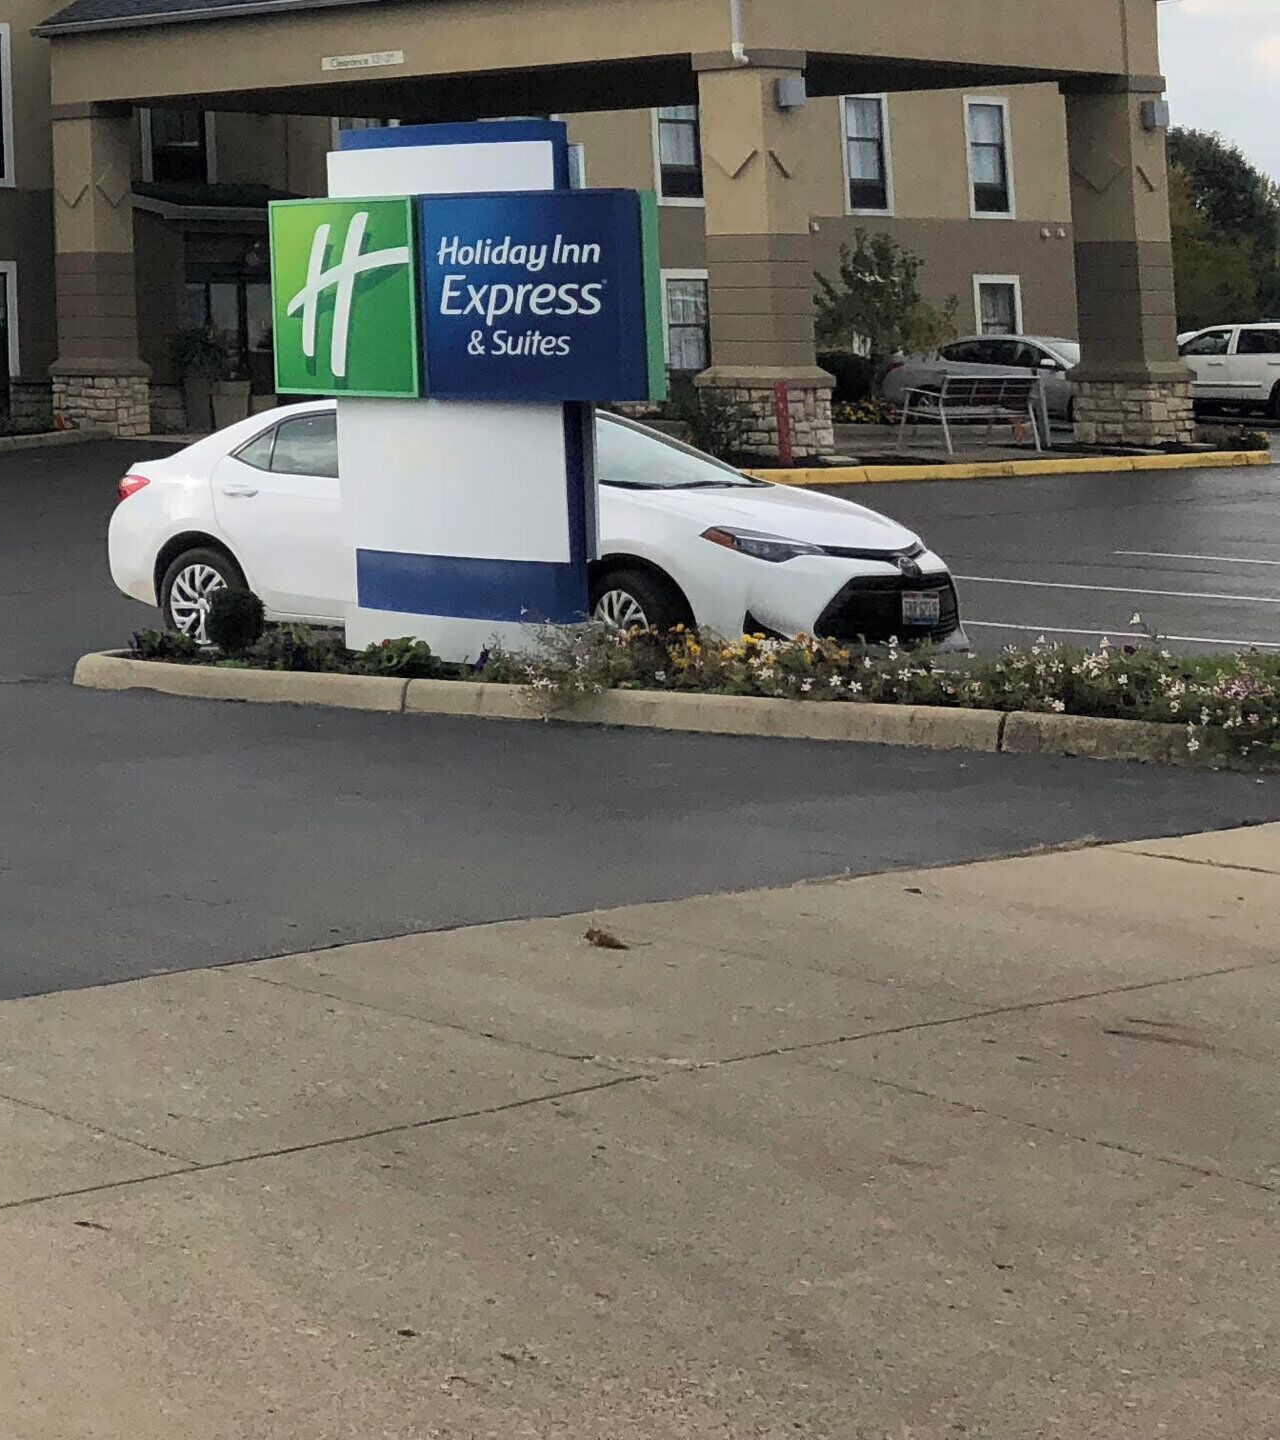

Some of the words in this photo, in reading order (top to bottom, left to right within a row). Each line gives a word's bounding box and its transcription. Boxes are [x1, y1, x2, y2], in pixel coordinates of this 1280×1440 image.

[330, 57, 369, 68] Clearance
[436, 235, 548, 272] Holiday
[552, 233, 601, 264] Inn
[439, 274, 603, 326] Express
[467, 329, 486, 356] &
[491, 329, 571, 356] Suites
